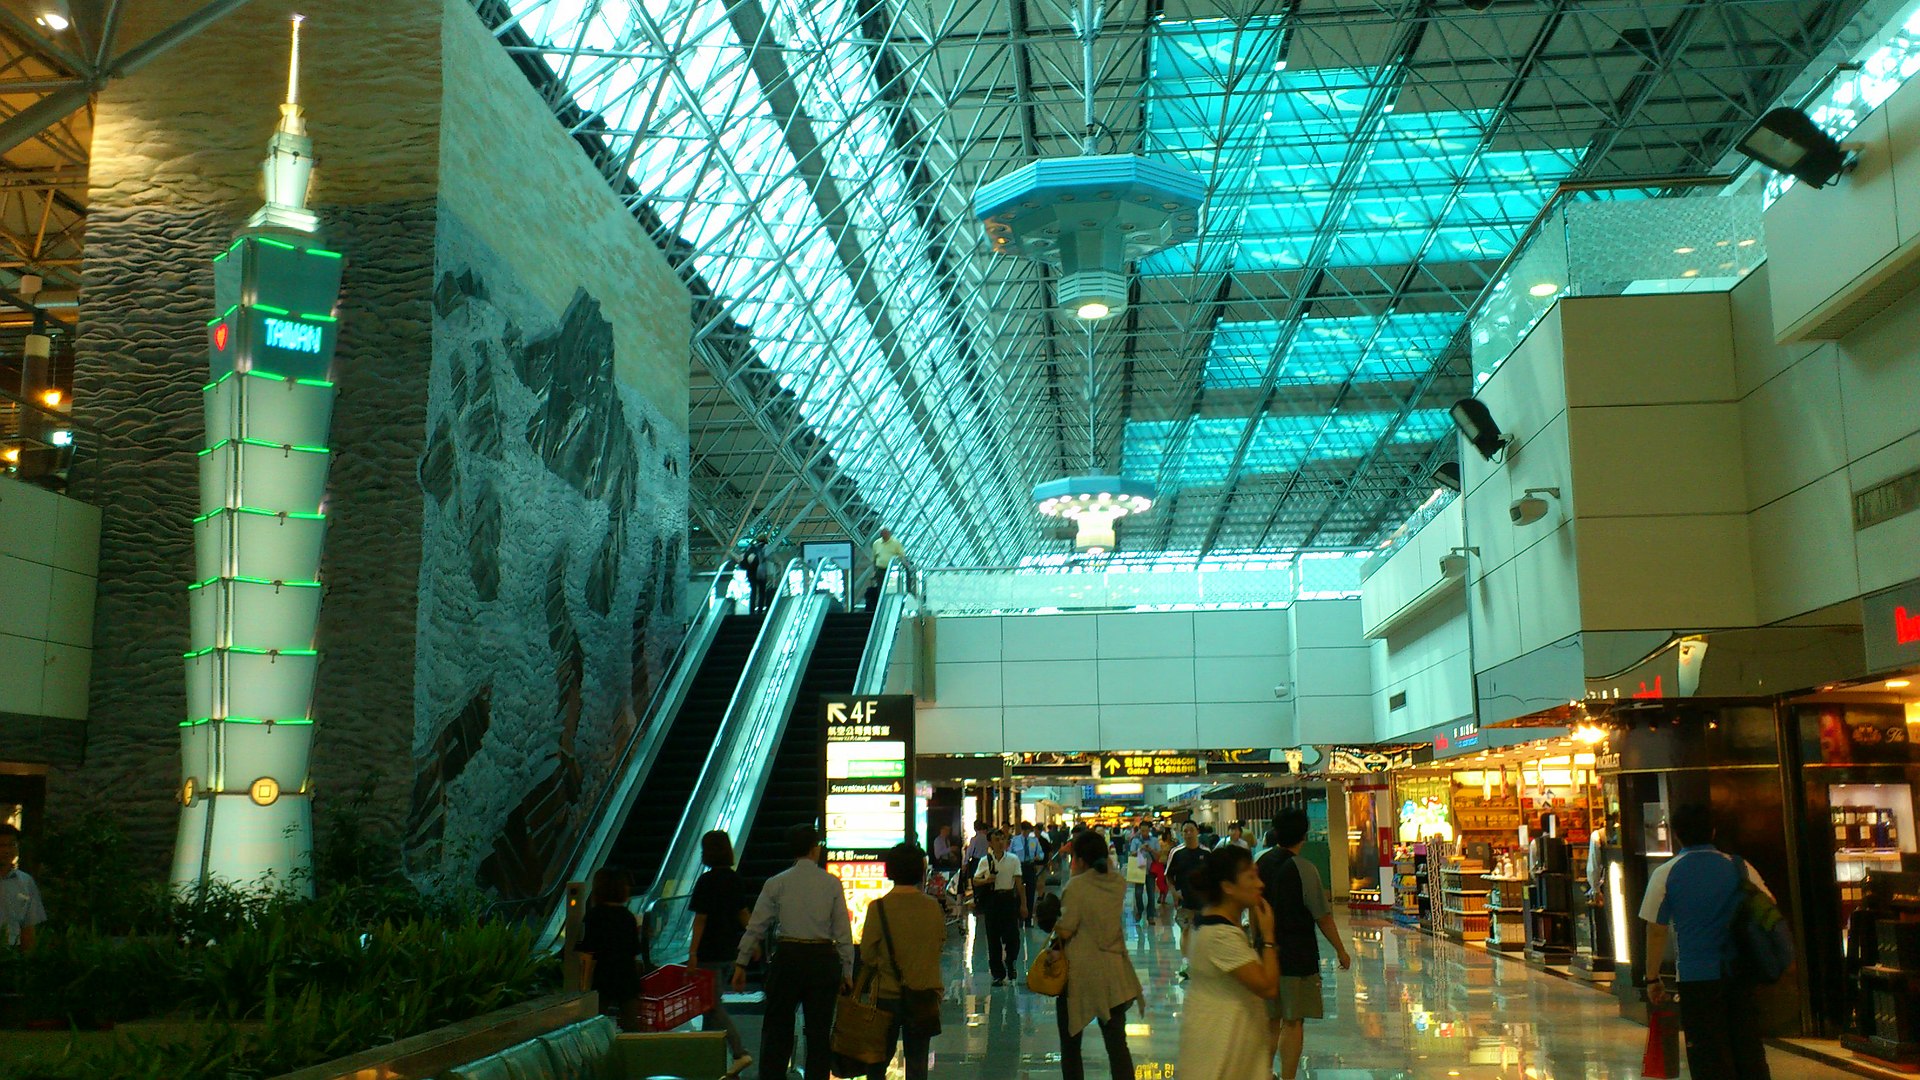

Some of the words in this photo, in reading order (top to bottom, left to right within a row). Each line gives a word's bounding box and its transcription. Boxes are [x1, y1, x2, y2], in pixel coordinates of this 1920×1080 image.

[264, 317, 323, 354] TAIWAN
[850, 701, 878, 724] 4F
[1126, 767, 1150, 775] Gates
